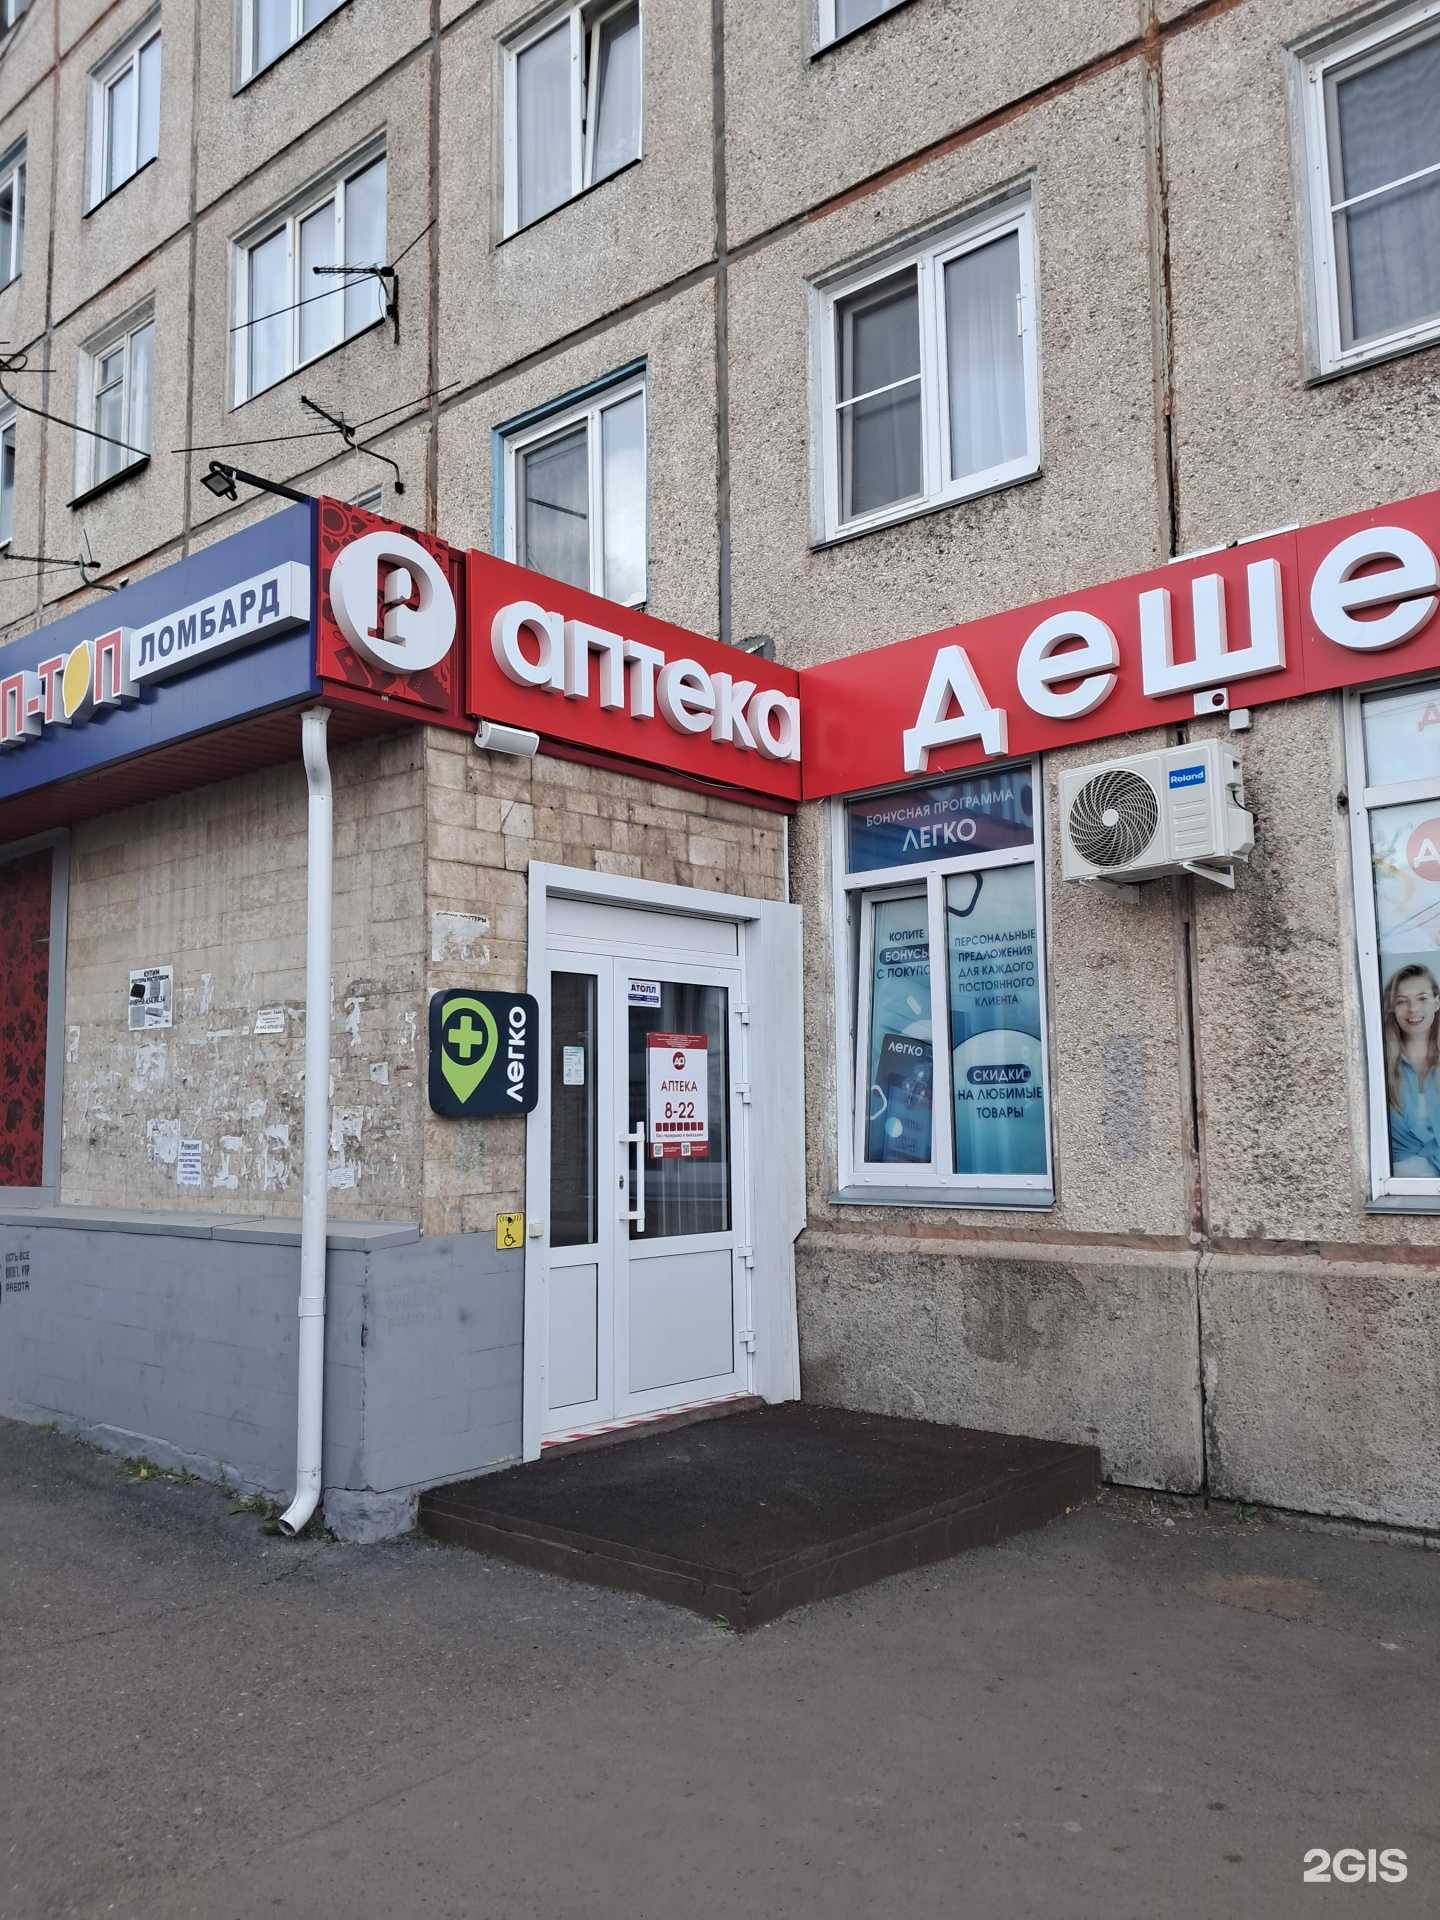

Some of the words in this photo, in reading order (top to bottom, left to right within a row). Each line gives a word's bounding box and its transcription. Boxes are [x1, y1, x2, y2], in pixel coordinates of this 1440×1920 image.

[139, 578, 280, 667] ЛОМБАРД
[491, 600, 801, 763] аптека
[1171, 771, 1204, 784] Roland
[866, 803, 931, 827] БОНУСНАЯ
[934, 789, 1014, 815] ПРОГРАММА
[902, 818, 977, 852] ЛЕГКО
[889, 929, 925, 942] КОПИТЕ
[954, 928, 1036, 947] ПЕРСОНАЛЬНЫЕ
[958, 945, 1033, 962] ПРЕДЛОЖЕНИЯ
[876, 968, 885, 980] С
[958, 966, 980, 979] ДЛЯ
[982, 961, 1034, 975] КАЖДОГО
[958, 977, 1035, 993] ПОСТОЯННОГО
[975, 994, 1019, 1008] КЛИЕНТА
[972, 1068, 1025, 1082] СКИДКИ
[661, 1080, 698, 1092] АПТЕКА
[958, 1088, 974, 1100] НА
[977, 1086, 1043, 1100] ЛЮБИМЫЕ
[664, 1101, 695, 1119] 8-22
[976, 1106, 1024, 1119] ТОВАРЫ
